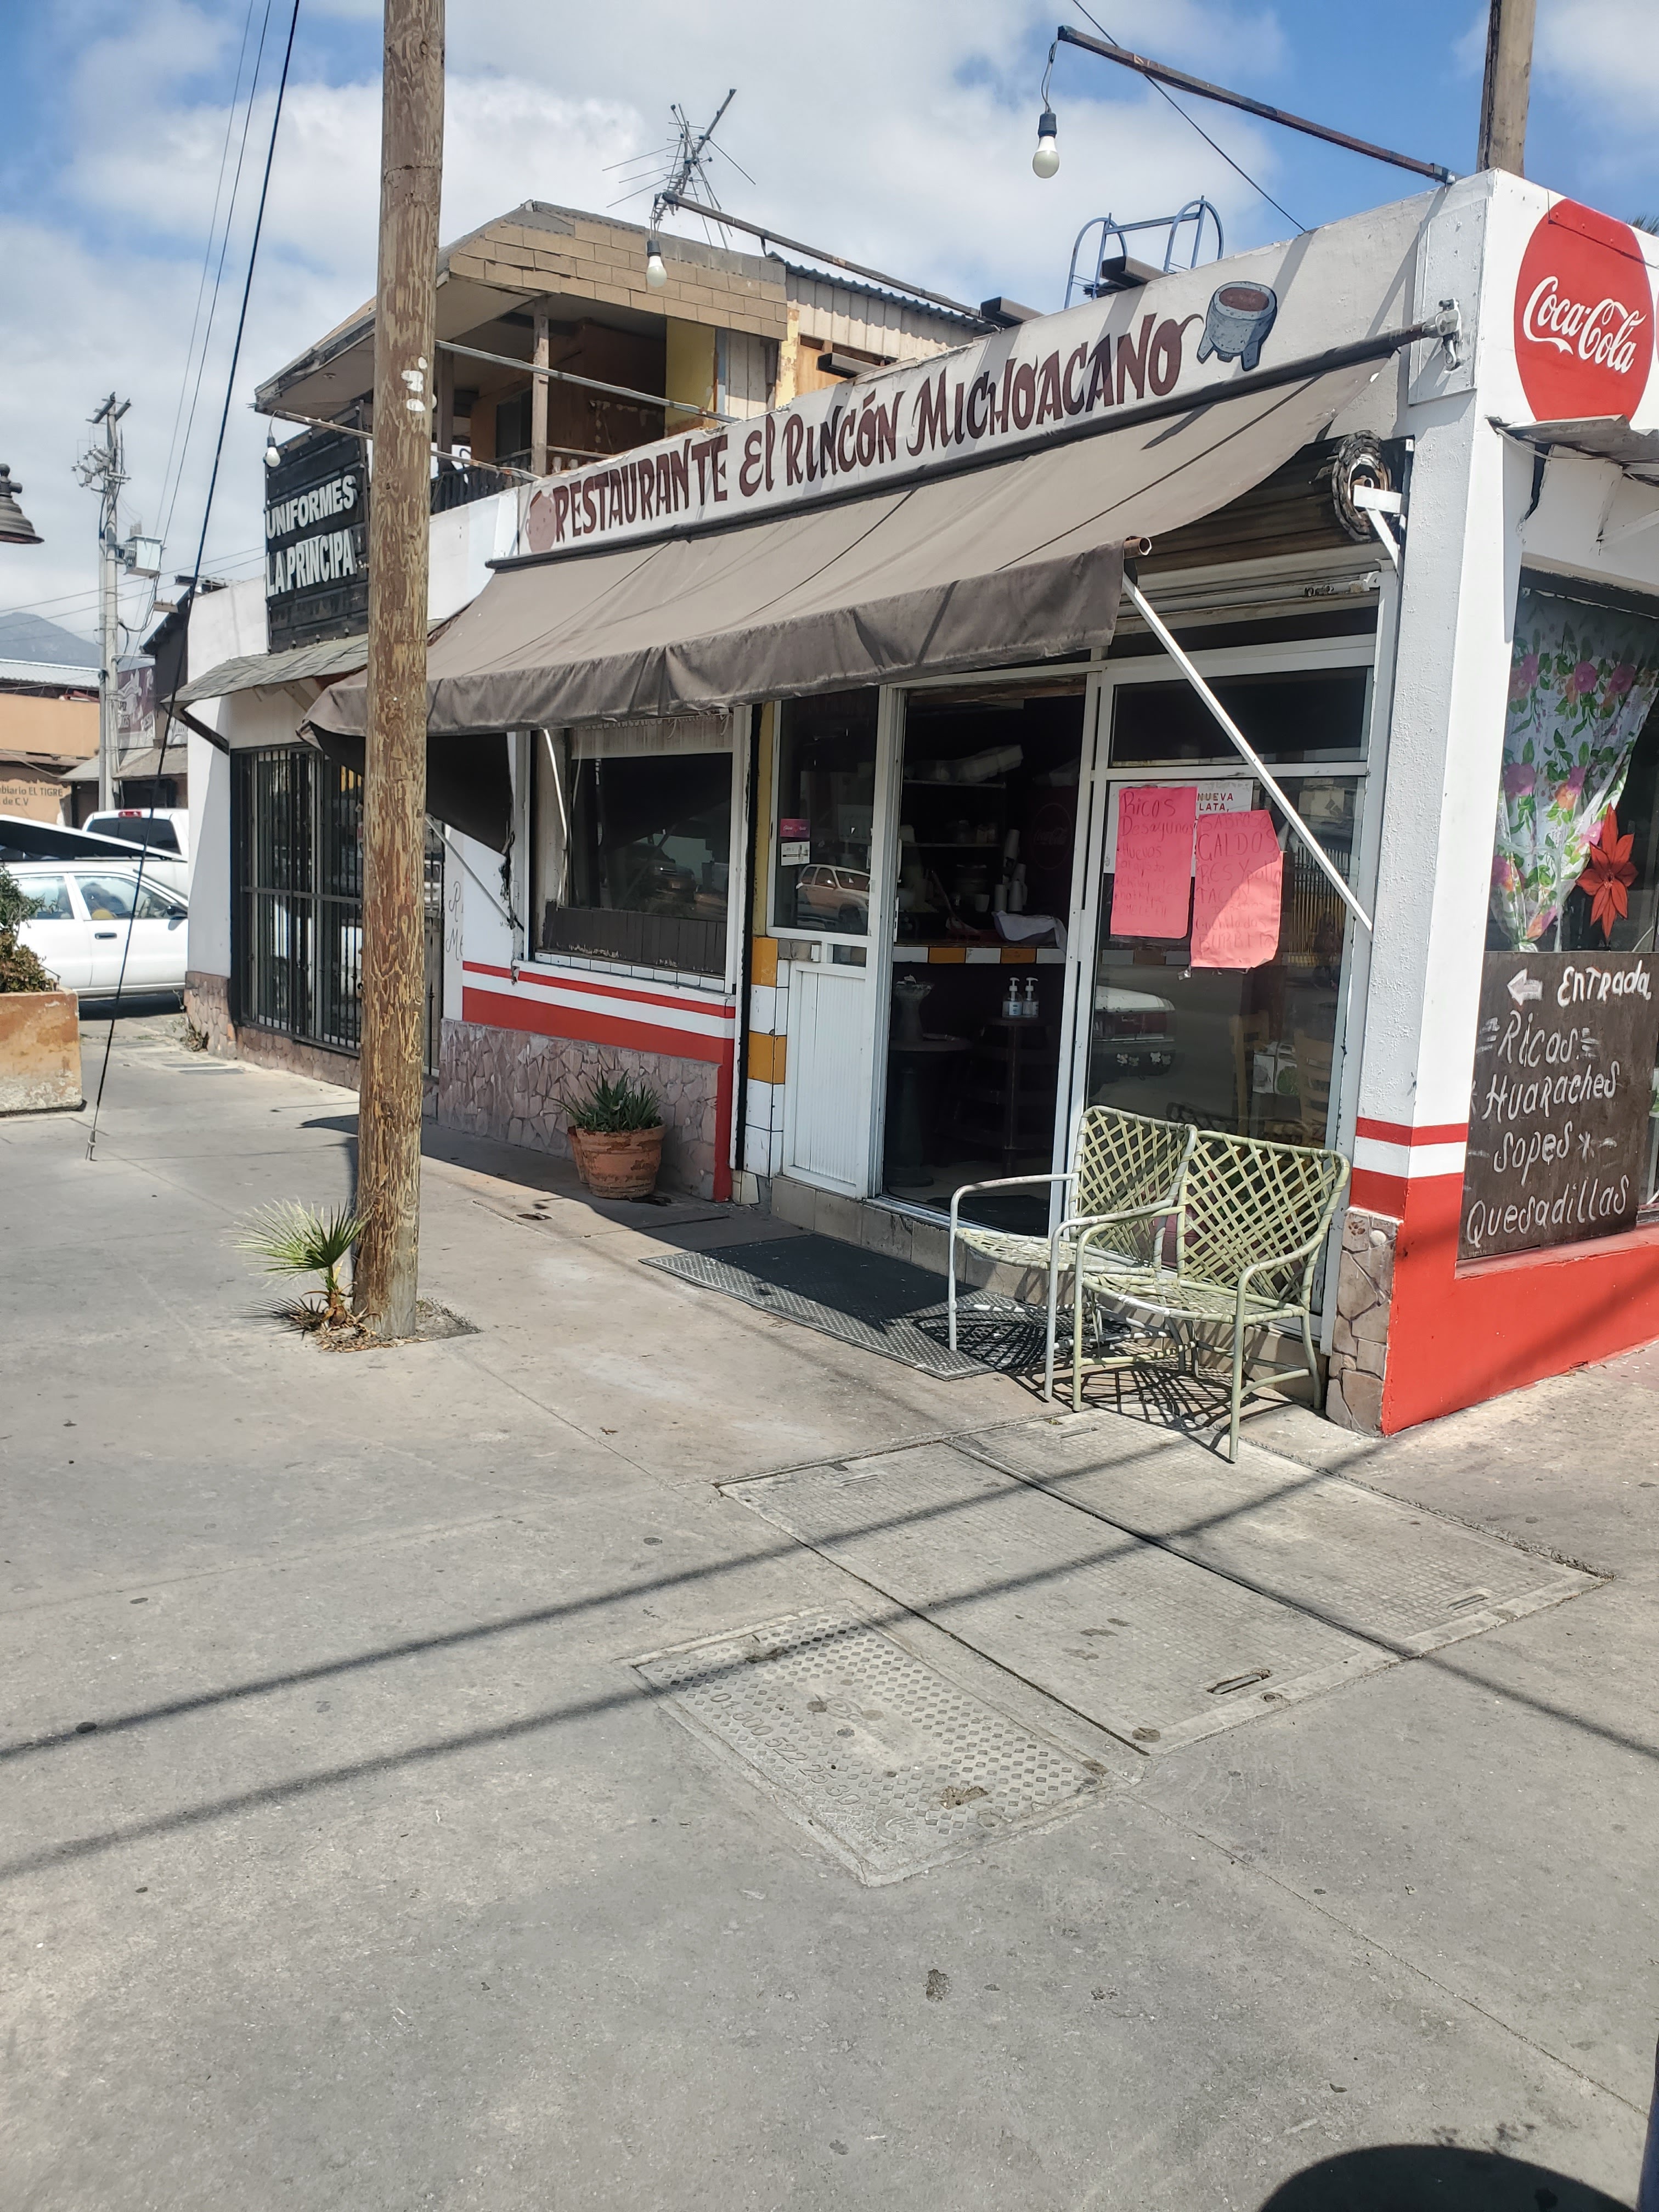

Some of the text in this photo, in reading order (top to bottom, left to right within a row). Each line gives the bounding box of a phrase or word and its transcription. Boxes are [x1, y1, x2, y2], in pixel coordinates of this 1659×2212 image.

[1523, 275, 1647, 373] Coca-Cola
[552, 435, 729, 544] RESTAURANTE
[783, 390, 906, 486] RINCÓN
[906, 312, 1204, 456] MICHOACANO
[266, 475, 358, 539] UNIFORMES
[266, 551, 286, 597] LA
[0, 785, 63, 797] biario EL TIGRE
[3, 796, 13, 805] de
[1197, 793, 1233, 802] NUEVA
[730, 1709, 775, 1737] 800
[764, 1735, 810, 1764] 522
[798, 1762, 837, 1786] 25
[824, 1784, 864, 1808] 30
